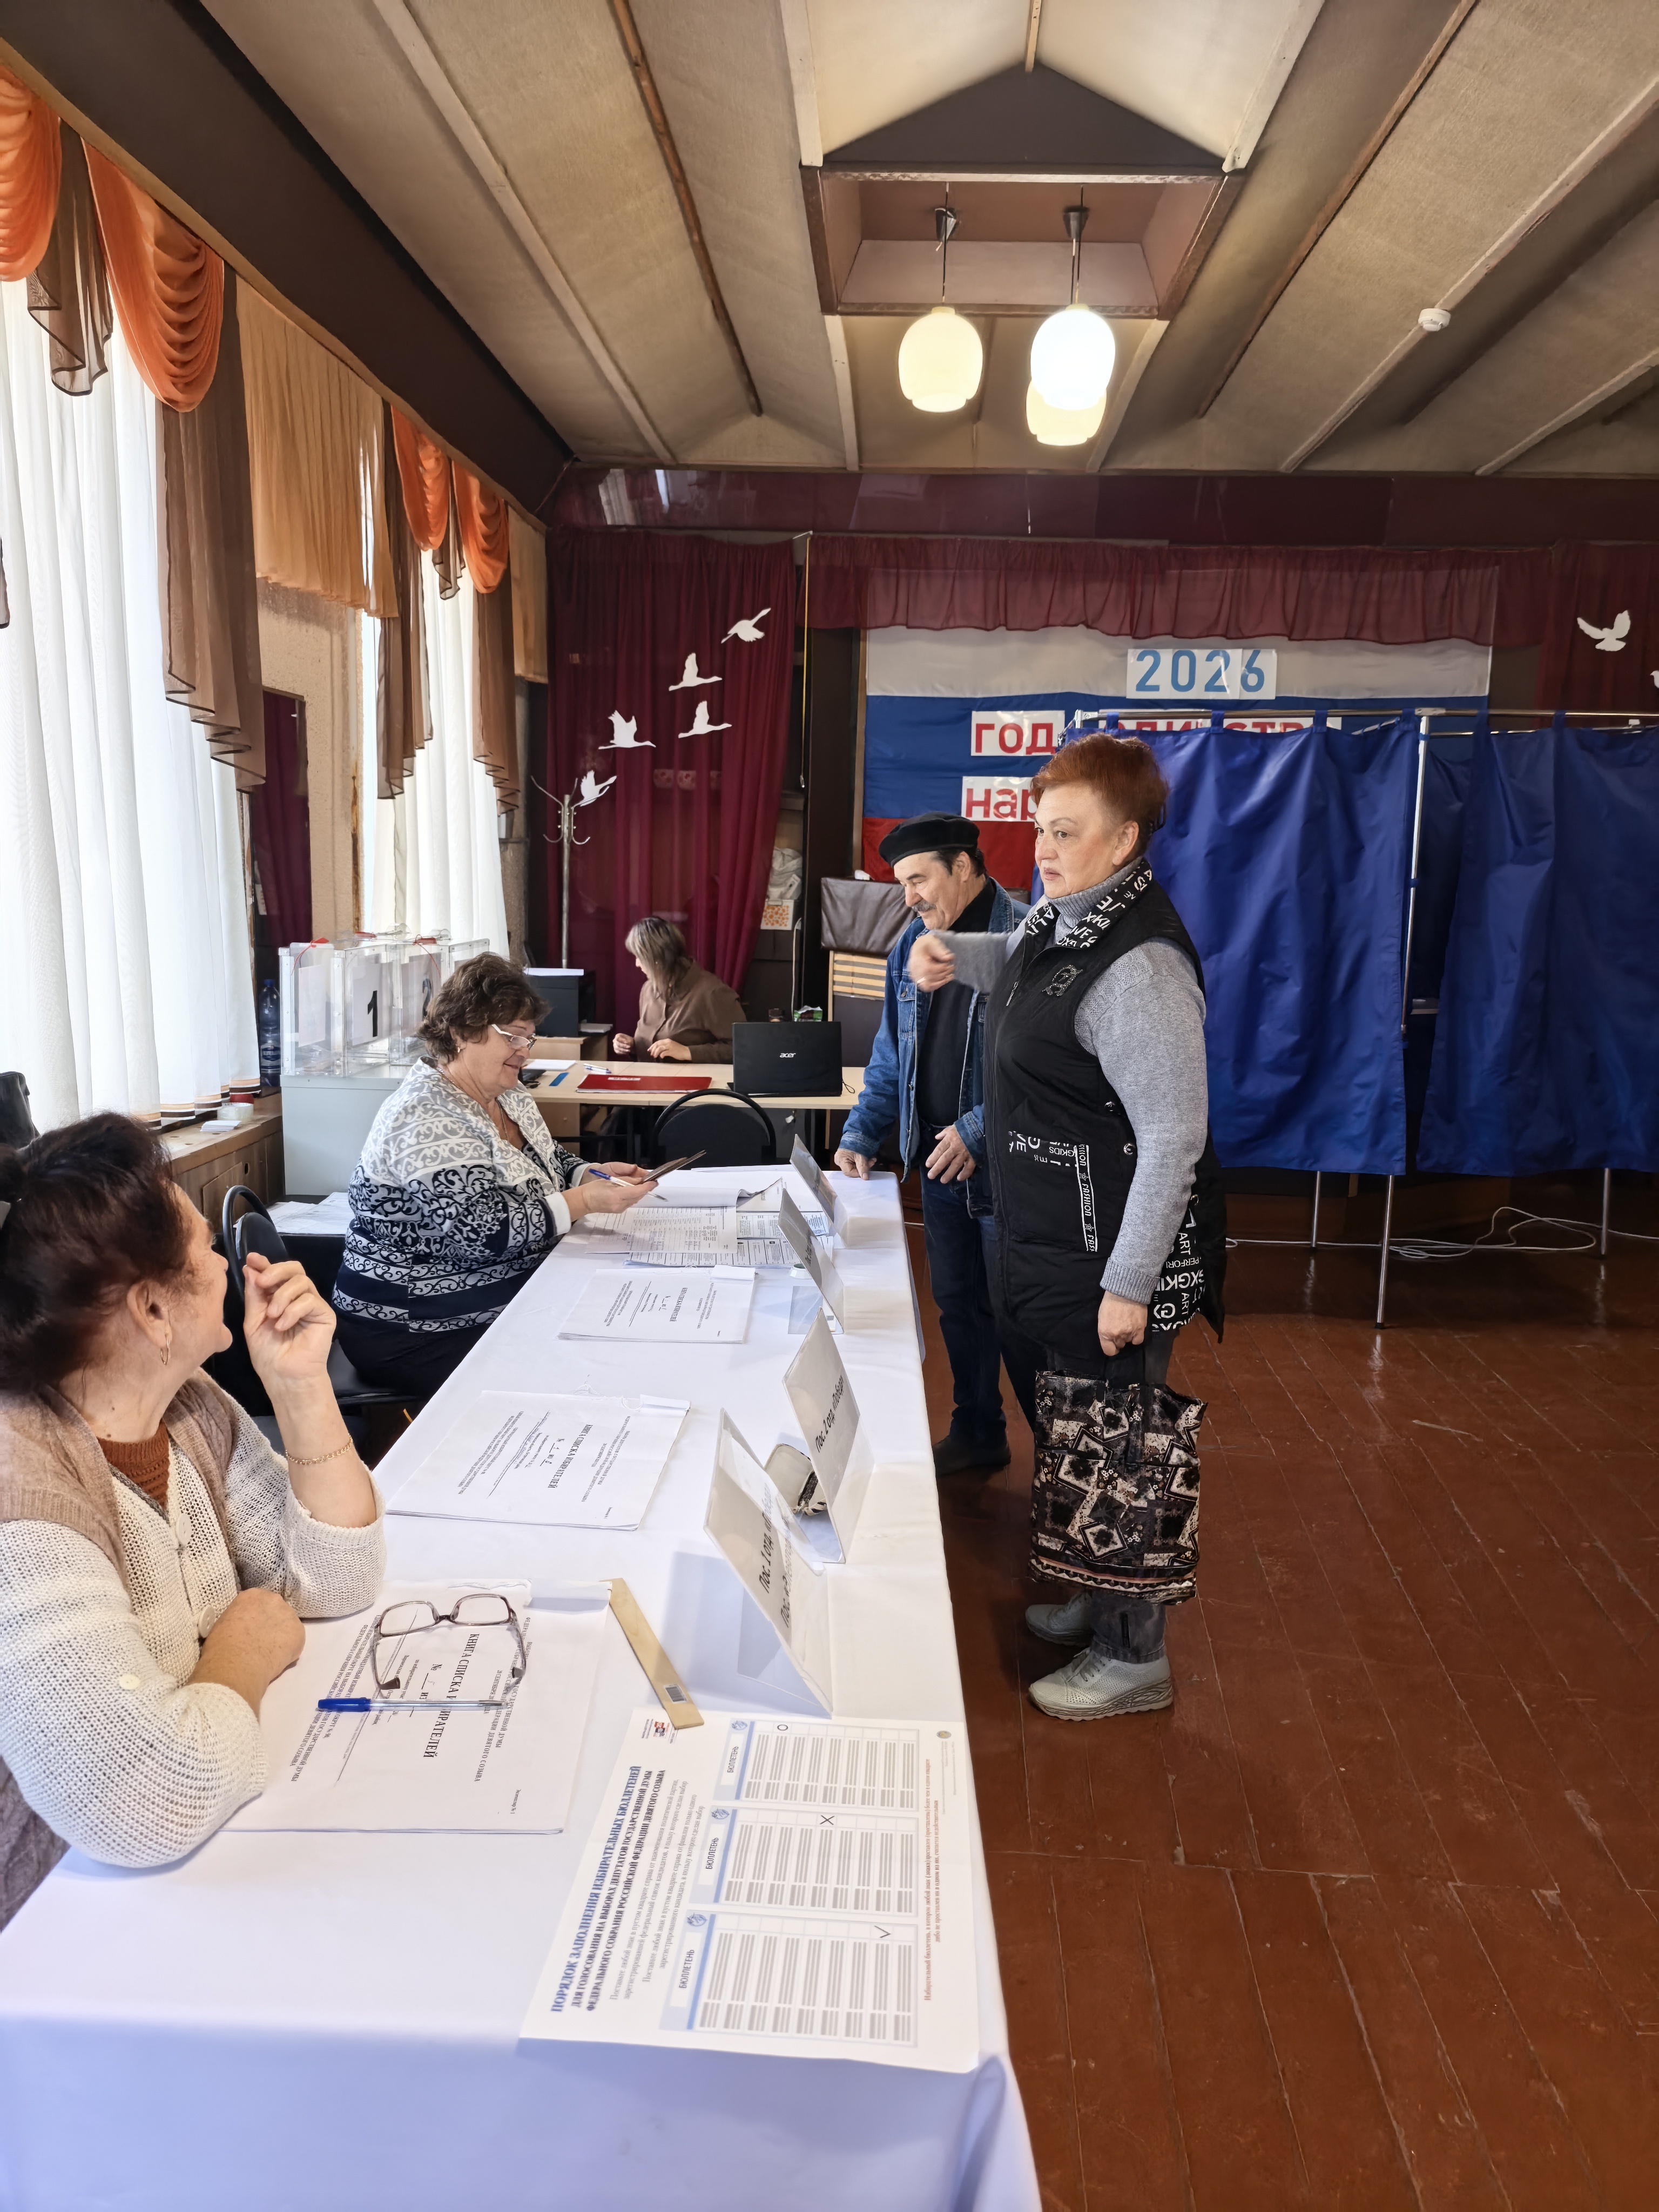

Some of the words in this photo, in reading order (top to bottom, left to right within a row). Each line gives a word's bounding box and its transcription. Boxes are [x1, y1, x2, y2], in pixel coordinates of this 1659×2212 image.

[1136, 650, 1265, 692] 2026
[368, 990, 377, 1037] 1
[1082, 1183, 1092, 1216] FASHION
[1178, 1232, 1191, 1255] ART
[578, 1424, 593, 1437] КНИГА
[815, 1431, 826, 1453] Пос.
[824, 1419, 828, 1435] 2
[566, 1437, 585, 1456] СПИСКА
[761, 1550, 771, 1566] 1
[759, 1566, 771, 1594] Пос.
[780, 1599, 790, 1628] Пос.
[461, 1633, 480, 1657] КНИГА
[347, 1659, 358, 1671] ОКРУГ
[448, 1659, 469, 1693] СПИСКА
[329, 1714, 340, 1727] ОКРУГ
[422, 1695, 457, 1757] ИИРАТЕЛЕЙ
[299, 1721, 326, 1765] ГОСУДАРСТВЕННОЙ
[300, 1724, 316, 1746] ДЕВЯТОГО
[481, 1731, 495, 1758] ДЕВЯТОГО
[495, 1732, 505, 1748] ДУМЫ
[289, 1748, 304, 1766] СОЗЫВА
[474, 1759, 487, 1782] СОЗЫВА
[291, 1766, 304, 1782] ДУМЫ
[640, 1770, 653, 1788] ДУМЫ
[621, 1788, 647, 1845] ГОСУДАРСТВЕННОЙ
[609, 1845, 630, 1886] ДЕПУТАТОВ
[704, 1837, 720, 1869] БЮЛЛЕТЕНЬ
[550, 1960, 578, 2012] ПОРЯДОК
[568, 1892, 601, 1959] ЗАПОЛНЕНИЯ
[591, 1817, 624, 1890] ИЗБИРАТЕЛЬНЫХ
[614, 1765, 641, 1816] БЮЛЛЕТЕНЕЙ
[585, 1950, 612, 2011] ФЕДЕРАЛЬНОГО
[604, 1910, 624, 1949] СОБРАНИЯ
[616, 1862, 638, 1908] РОССИЙСКОЙ
[630, 1823, 650, 1860] ФЕДЕРАЦИИ
[643, 1792, 659, 1822] ДЕВЯТОГО
[652, 1769, 666, 1792] СОЗЫВА
[644, 1869, 655, 1886] справа
[598, 1886, 617, 1919] ВЫБОРАХ
[638, 1887, 651, 1910] квадрате
[595, 1921, 606, 1932] НА
[632, 1911, 644, 1930] пустом
[638, 1901, 657, 1938] федеральный
[576, 1933, 603, 1990] ГОЛОСОВАНИЯ
[677, 1948, 697, 1989] БЮЛЛЕТЕНЬ
[570, 1991, 585, 2007] ДЛЯ
